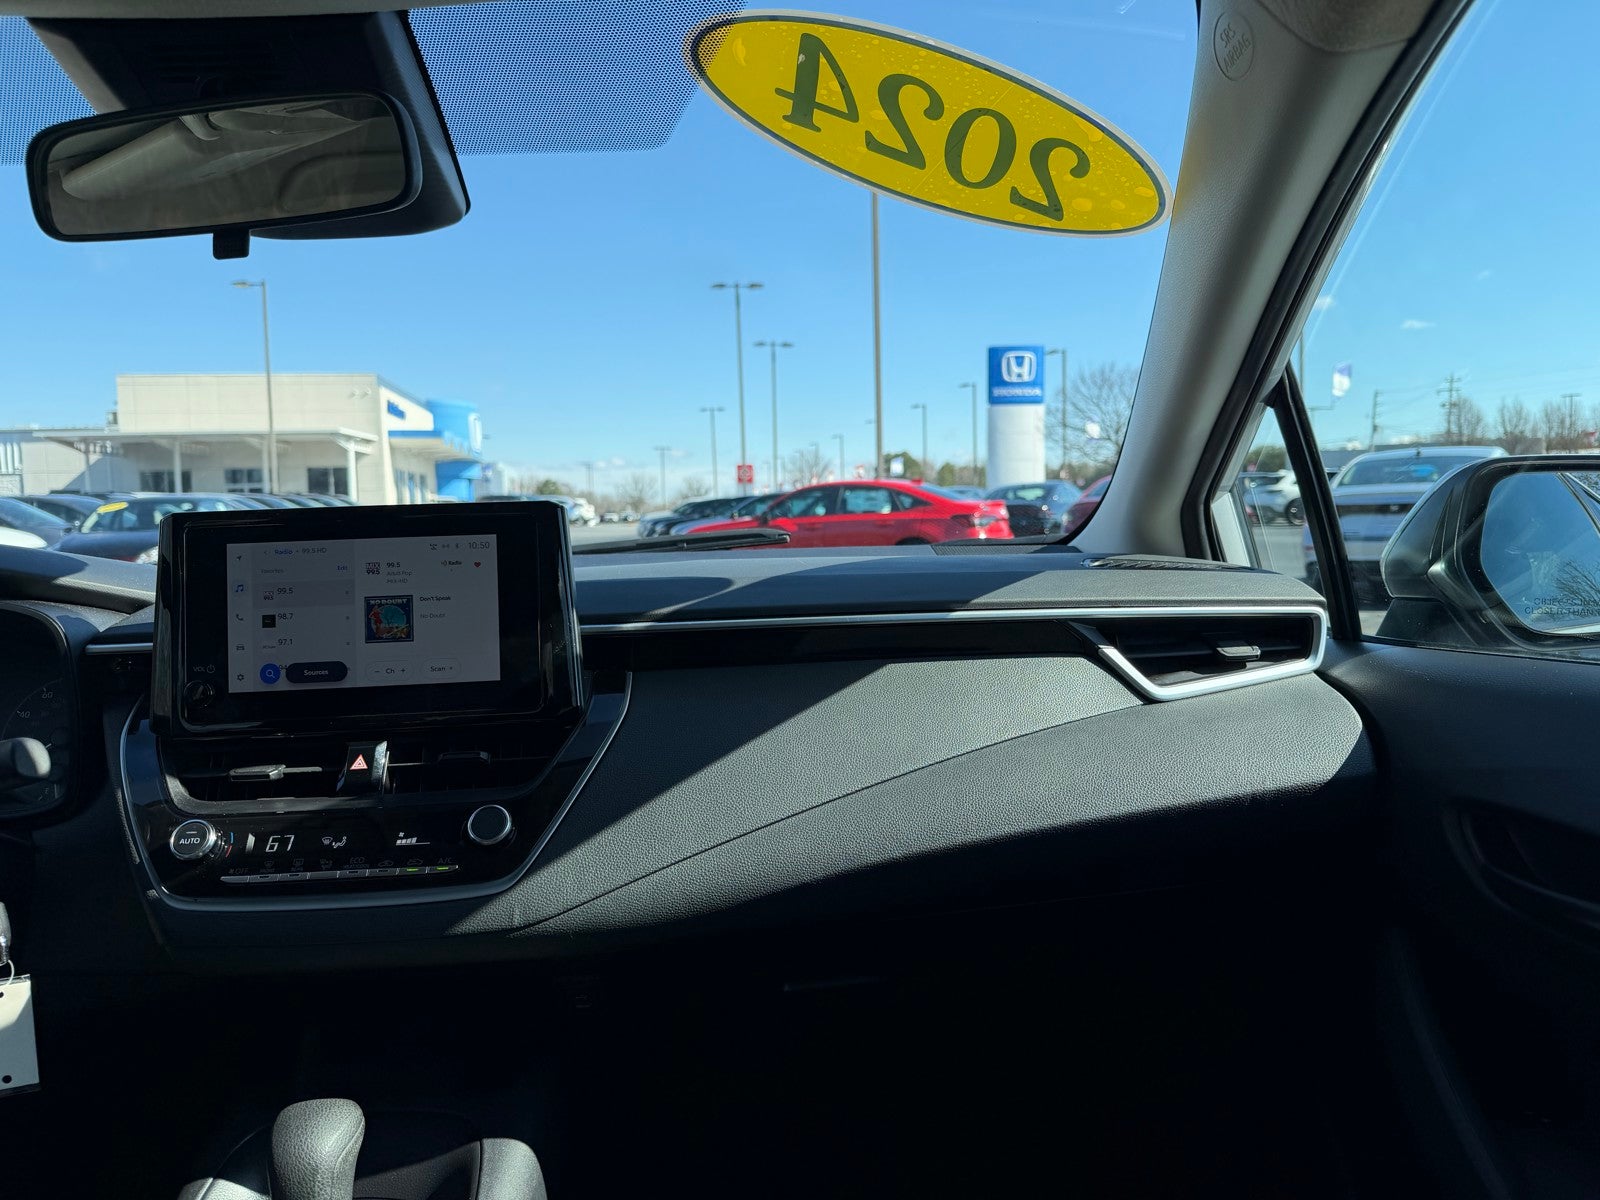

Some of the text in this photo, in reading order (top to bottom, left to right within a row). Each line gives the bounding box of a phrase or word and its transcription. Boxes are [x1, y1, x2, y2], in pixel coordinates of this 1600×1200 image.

[1220, 22, 1236, 48] SRS
[1223, 32, 1251, 72] AIRBAG
[468, 541, 490, 550] 10:50
[274, 548, 294, 556] Radio
[386, 561, 401, 569] 99.5
[276, 587, 294, 595] 99.5
[435, 595, 452, 603] Speak
[1524, 606, 1594, 617] CLOSER THAN
[277, 612, 294, 621] 98.7
[277, 638, 294, 647] 97.1
[303, 668, 329, 677] Sources
[385, 667, 395, 675] Ch
[430, 665, 446, 673] Scan
[179, 836, 201, 845] AUTO
[265, 834, 296, 853] 67
[437, 857, 453, 865] A/C
